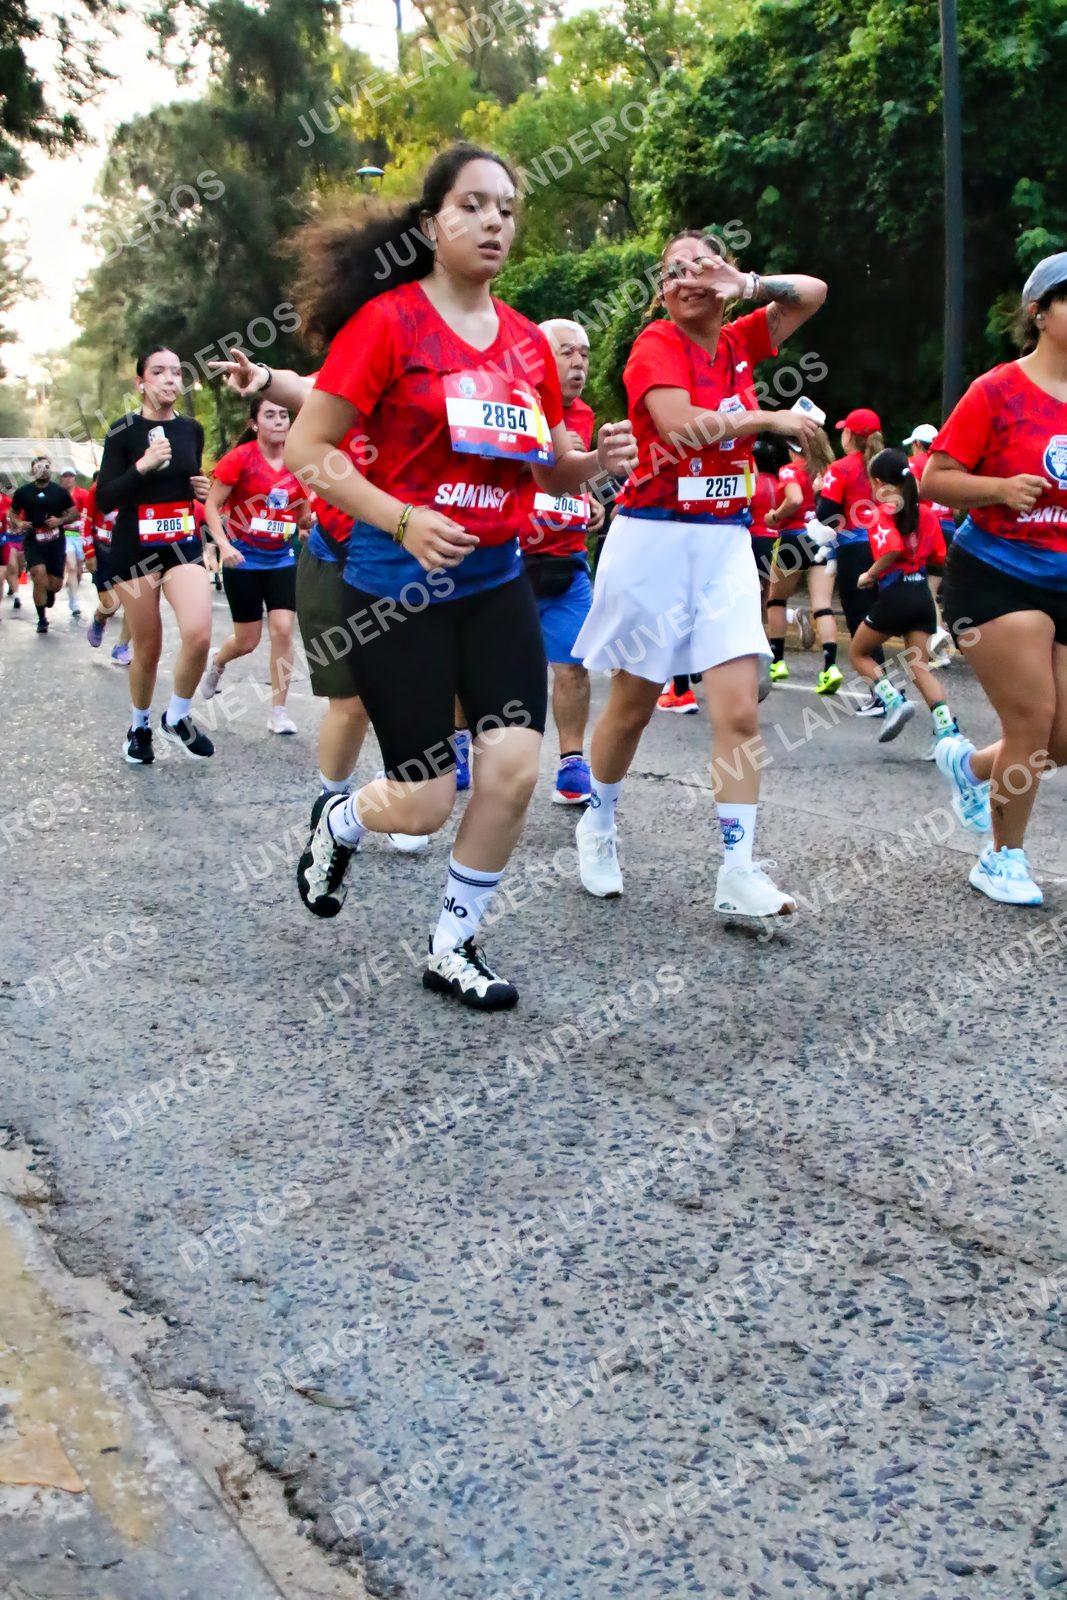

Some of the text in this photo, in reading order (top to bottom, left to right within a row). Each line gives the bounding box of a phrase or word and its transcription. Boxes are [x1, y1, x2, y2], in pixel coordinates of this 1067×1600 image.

[482, 402, 528, 432] 2854
[705, 476, 739, 498] 2257
[554, 495, 579, 514] 3045
[156, 518, 182, 532] 2805
[267, 521, 285, 533] 2310
